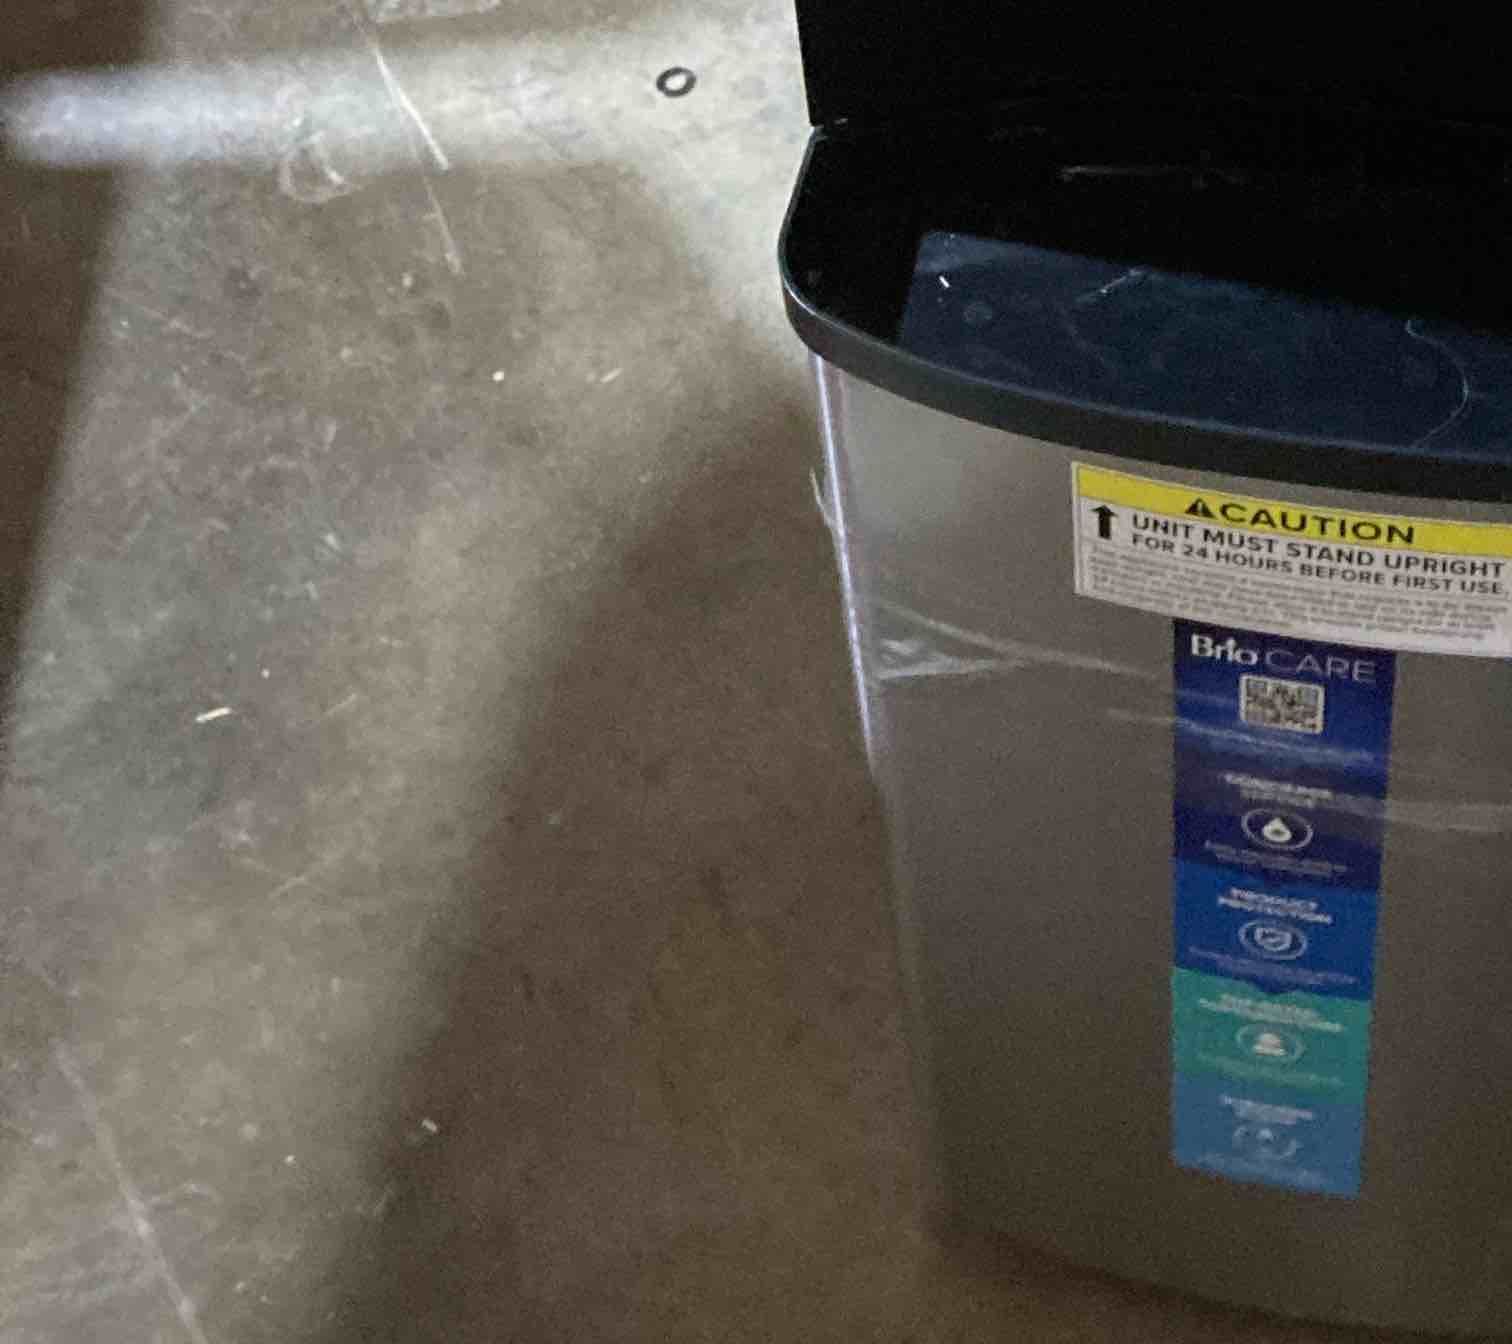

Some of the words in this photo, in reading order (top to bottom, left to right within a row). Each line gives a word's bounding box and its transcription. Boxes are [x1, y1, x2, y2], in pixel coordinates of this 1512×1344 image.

[1132, 513, 1194, 539] UNIT
[1203, 528, 1280, 554] MUST
[1286, 541, 1375, 567] STAND
[1384, 552, 1506, 579] UPRIGHT
[1219, 502, 1415, 545] CAUTION
[1132, 532, 1175, 554] FOR
[1183, 543, 1208, 559] 24
[1215, 549, 1294, 574] HOURS
[1299, 562, 1385, 586] BEFORE
[1392, 573, 1453, 593] FIRST
[1191, 633, 1258, 666] Brio
[1264, 648, 1376, 682] CARE
